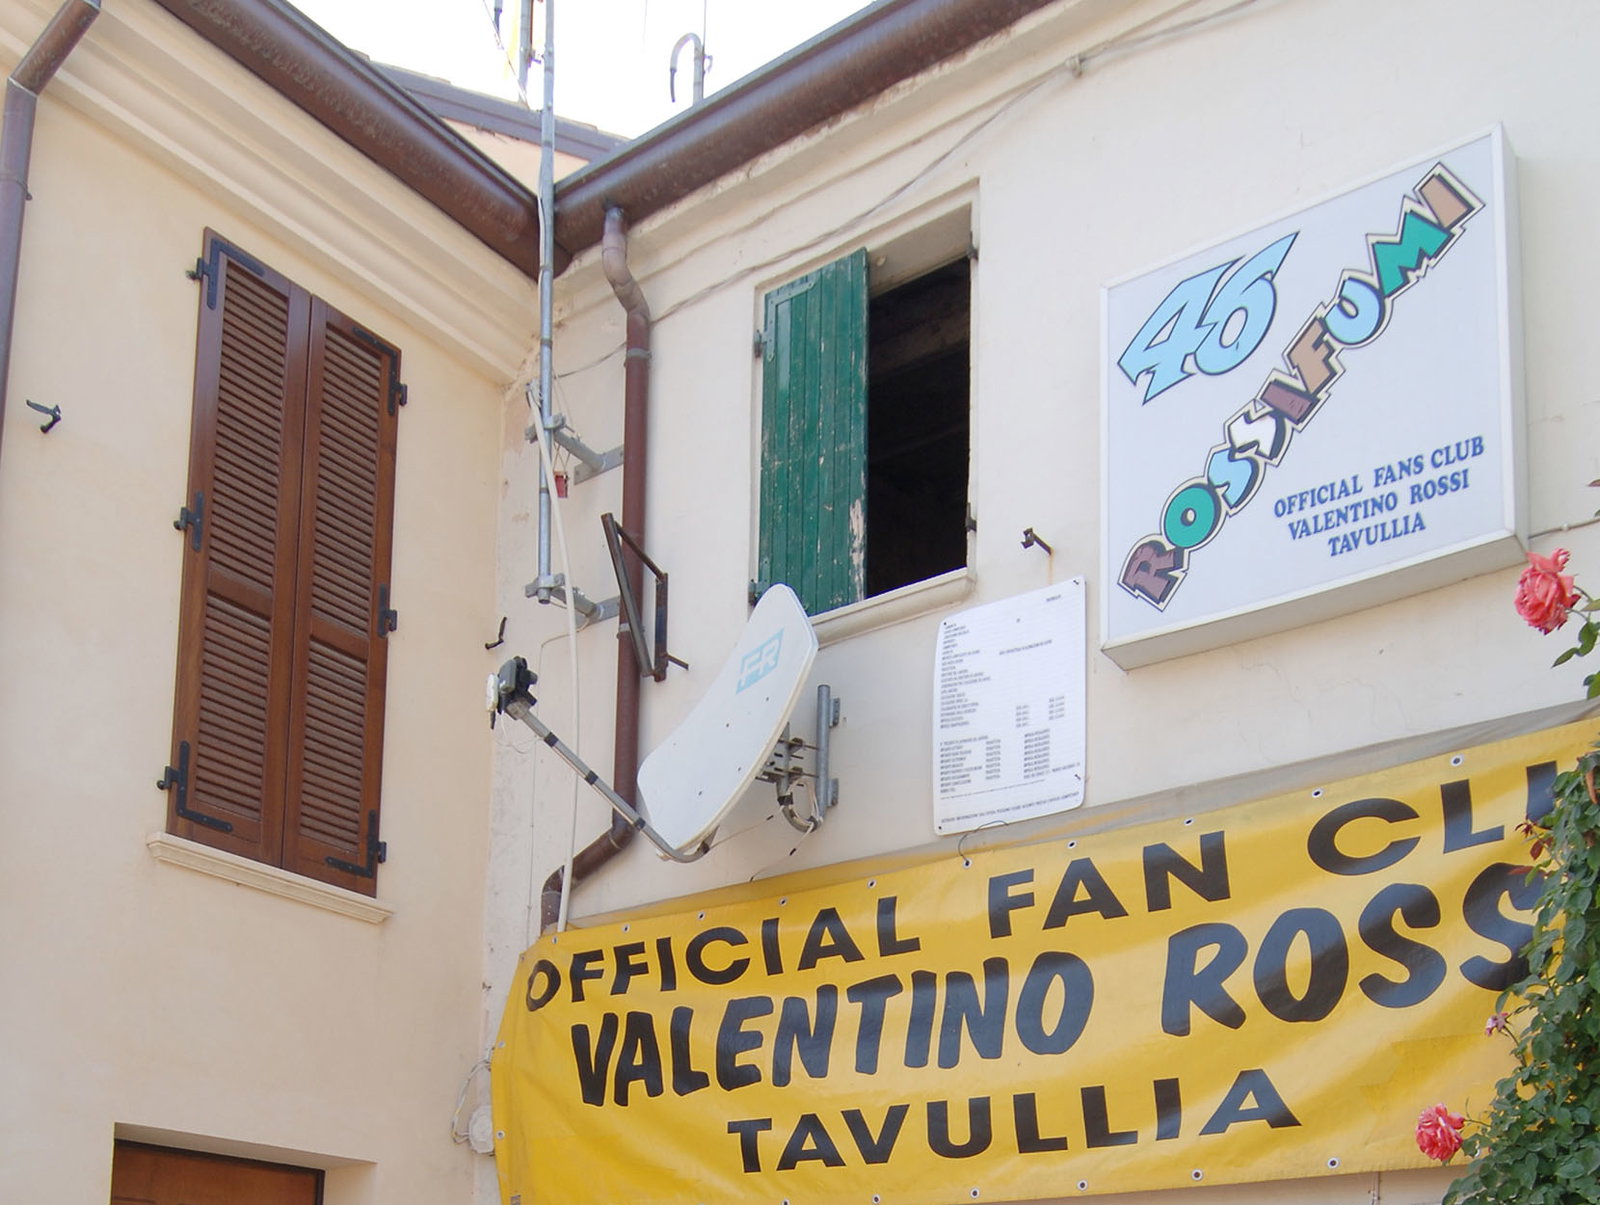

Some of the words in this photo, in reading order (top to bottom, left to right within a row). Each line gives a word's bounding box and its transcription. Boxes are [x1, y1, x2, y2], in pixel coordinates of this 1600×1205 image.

[1117, 232, 1299, 405] 46
[1274, 474, 1363, 518] OFFICIAL
[1374, 454, 1424, 488] FANS
[1431, 435, 1484, 468] CLUB
[1288, 492, 1398, 540] VALENTINO
[1410, 468, 1469, 504] ROSSI
[1328, 512, 1426, 556] TAVULLIA
[526, 896, 921, 1011] OFFICIAL
[988, 830, 1231, 939] FAN
[1307, 760, 1557, 876] CL
[571, 951, 1094, 1107] VALENTINO
[1161, 862, 1546, 1036] ROSS
[728, 1068, 1302, 1173] TAVULLIA
